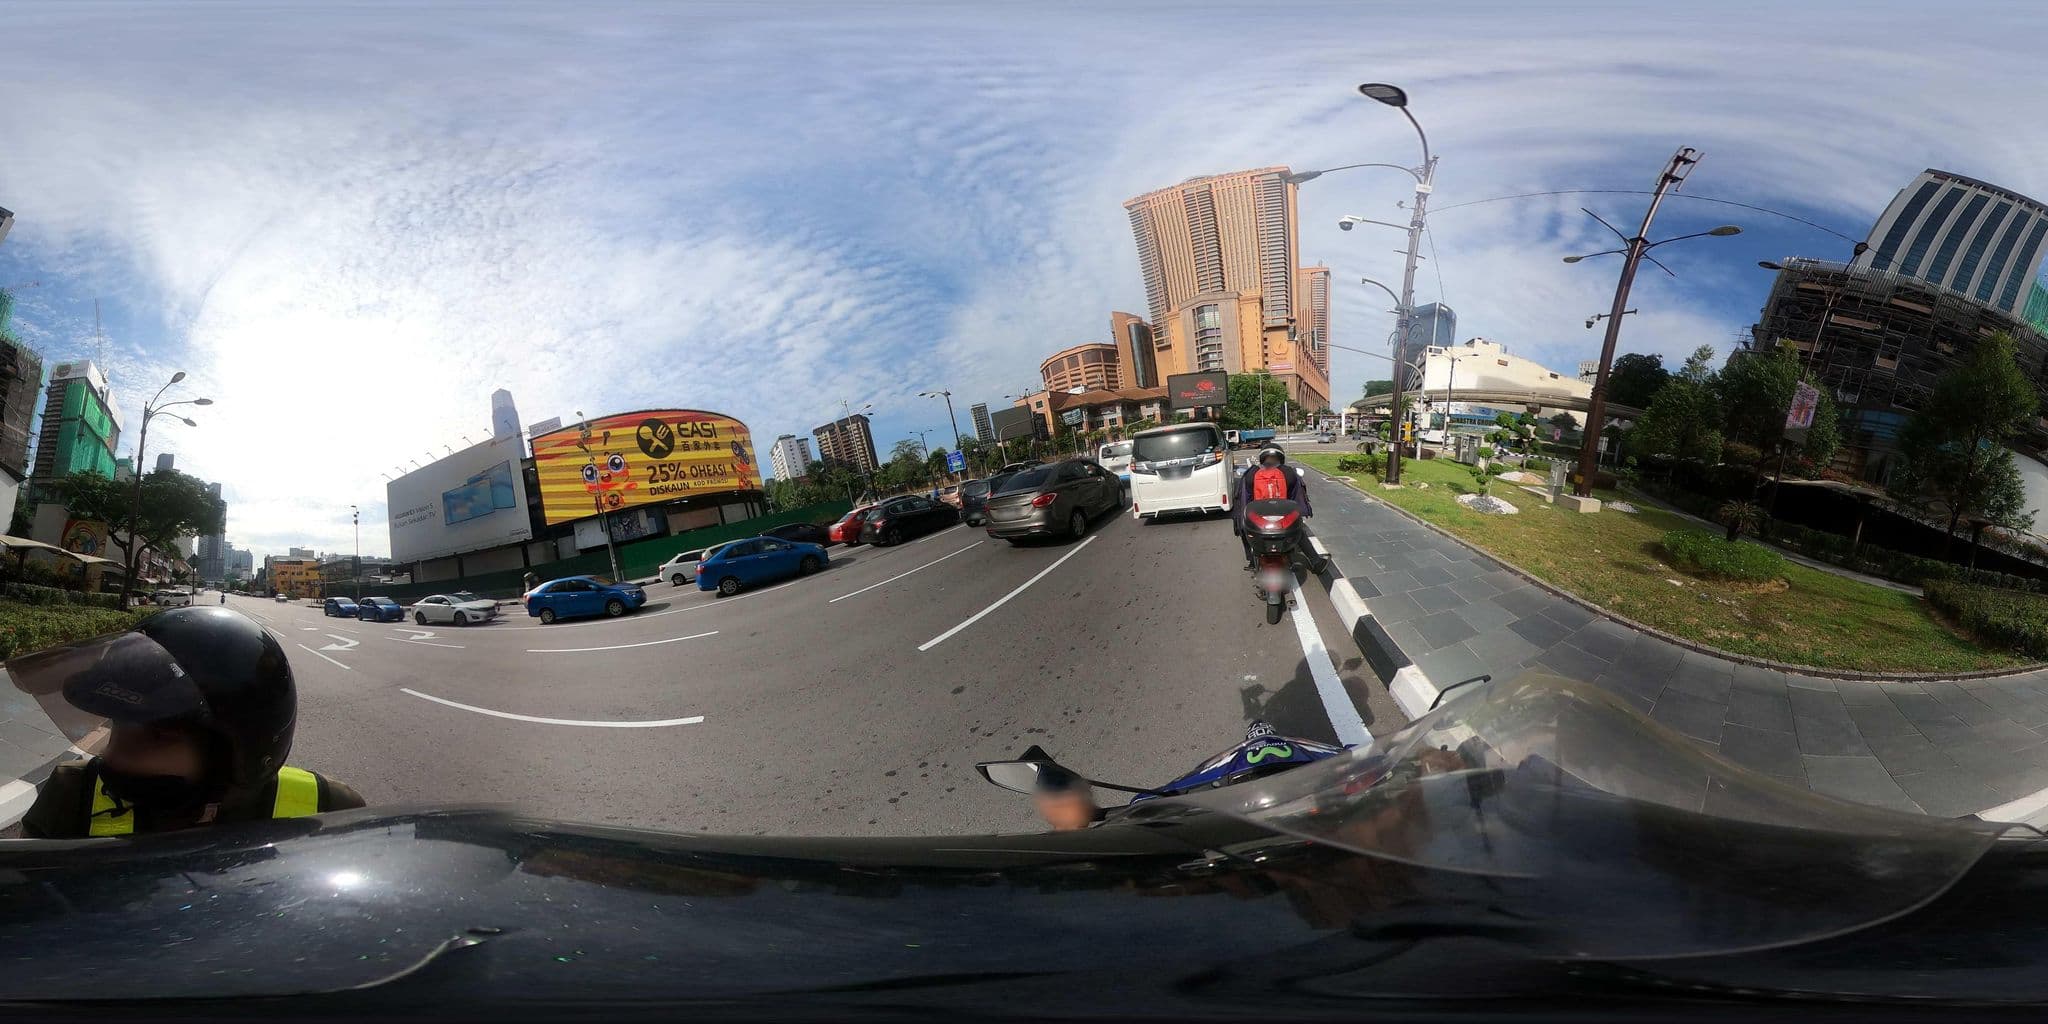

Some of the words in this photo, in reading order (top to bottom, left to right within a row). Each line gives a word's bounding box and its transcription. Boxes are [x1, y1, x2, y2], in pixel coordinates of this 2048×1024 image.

[677, 422, 717, 438] EASI
[647, 462, 686, 484] 25%
[690, 464, 727, 478] OHEASI
[650, 482, 690, 496] DISKAUN
